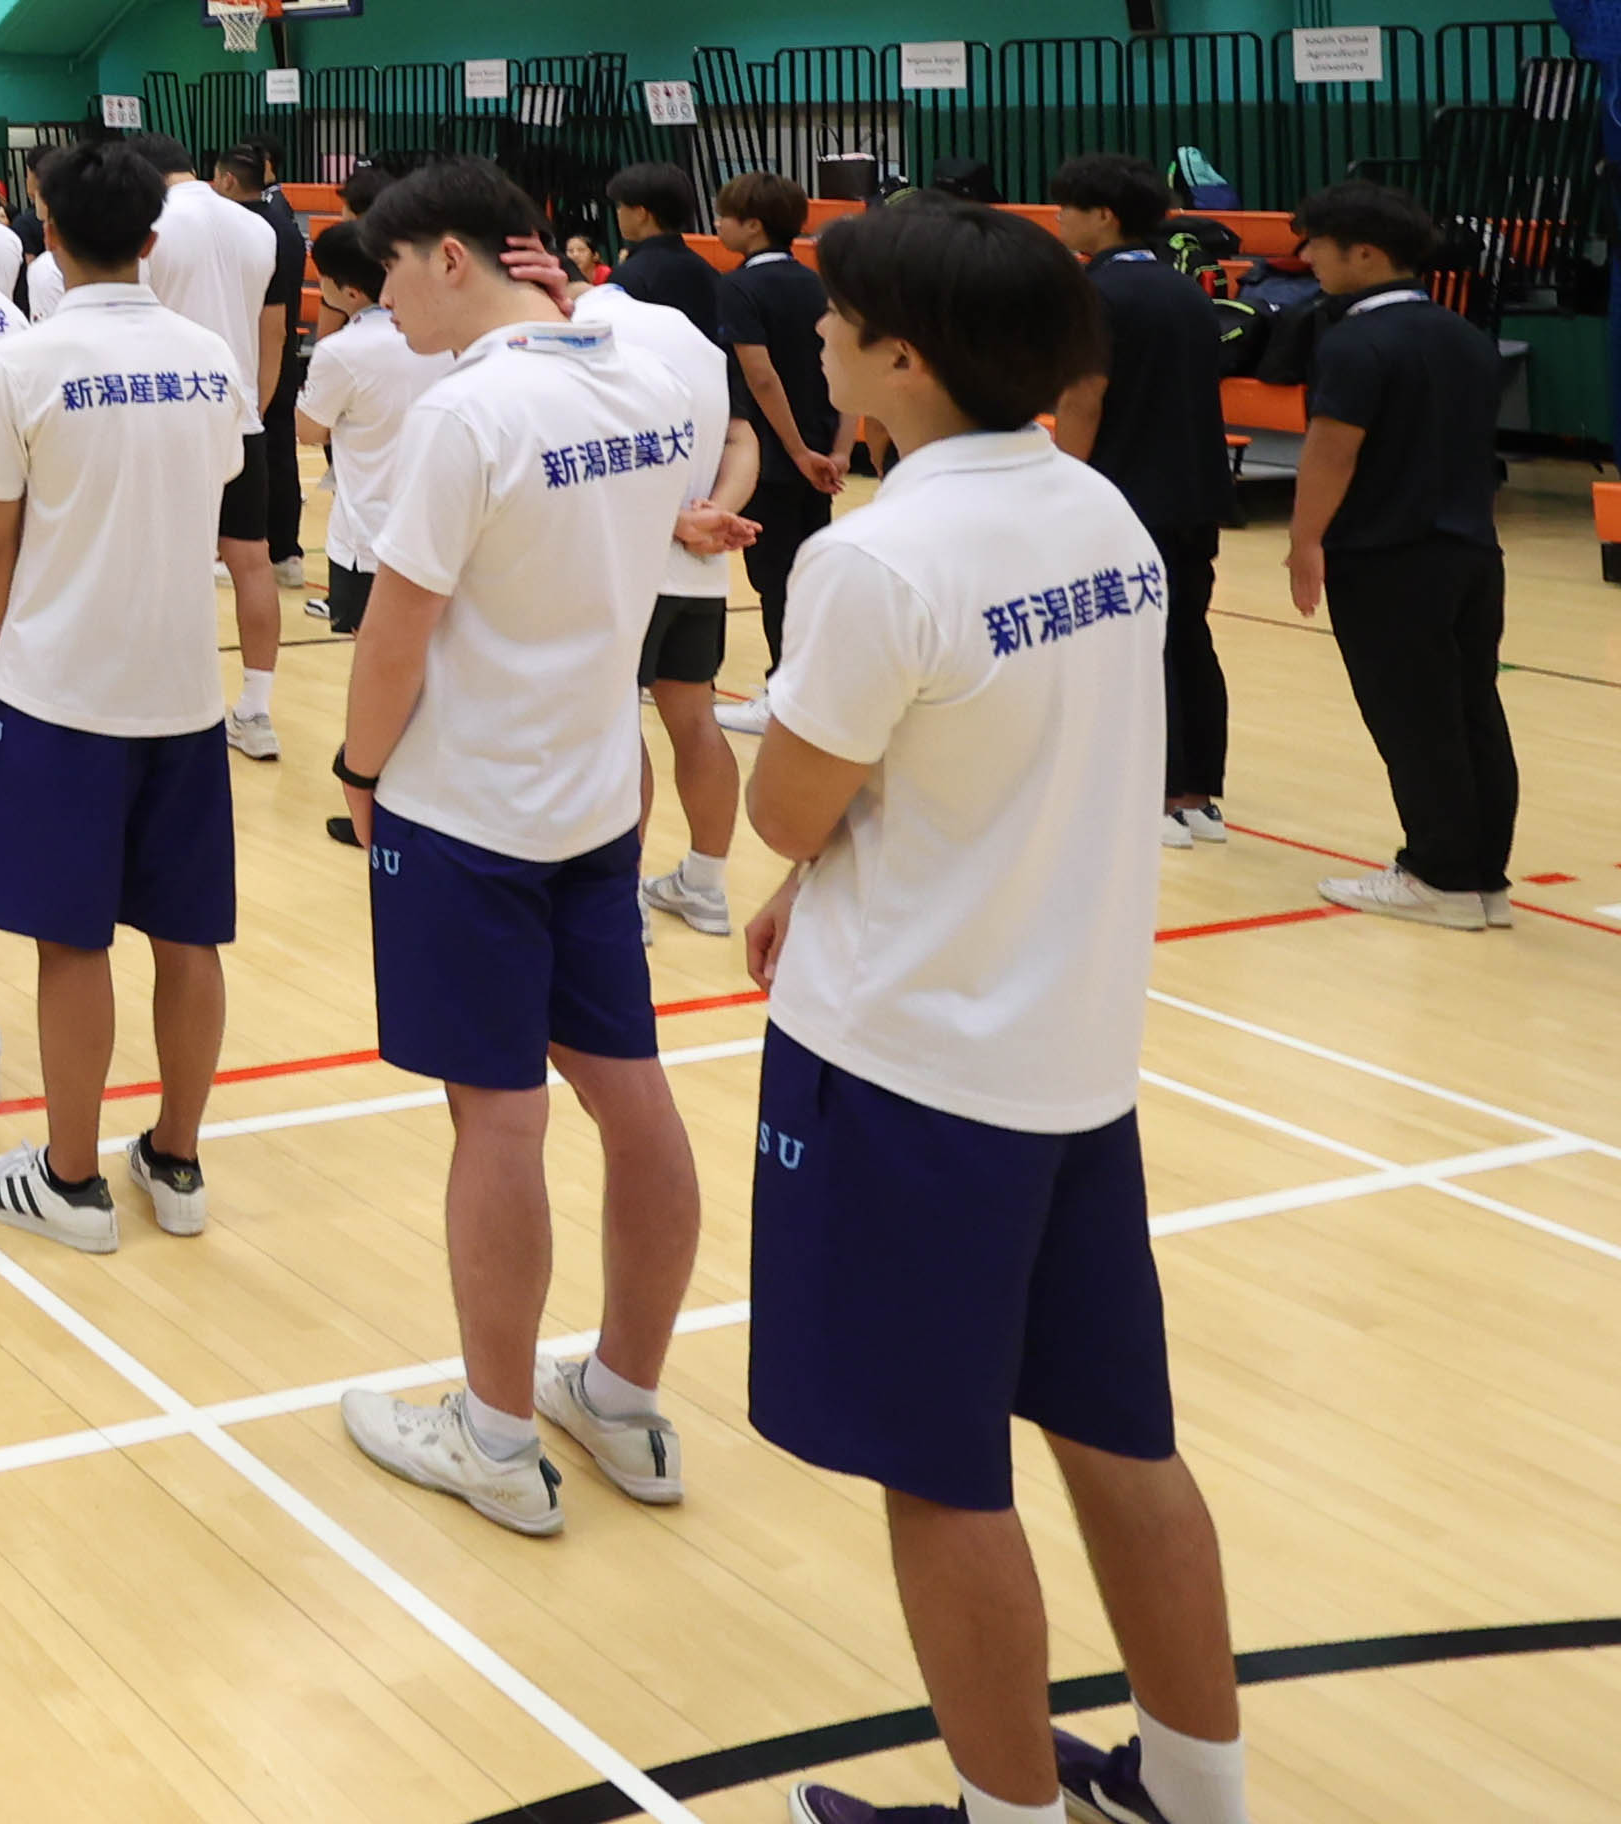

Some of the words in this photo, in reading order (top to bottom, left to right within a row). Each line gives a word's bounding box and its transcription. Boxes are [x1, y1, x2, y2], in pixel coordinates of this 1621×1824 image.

[61, 370, 228, 412] 新潟産業大学
